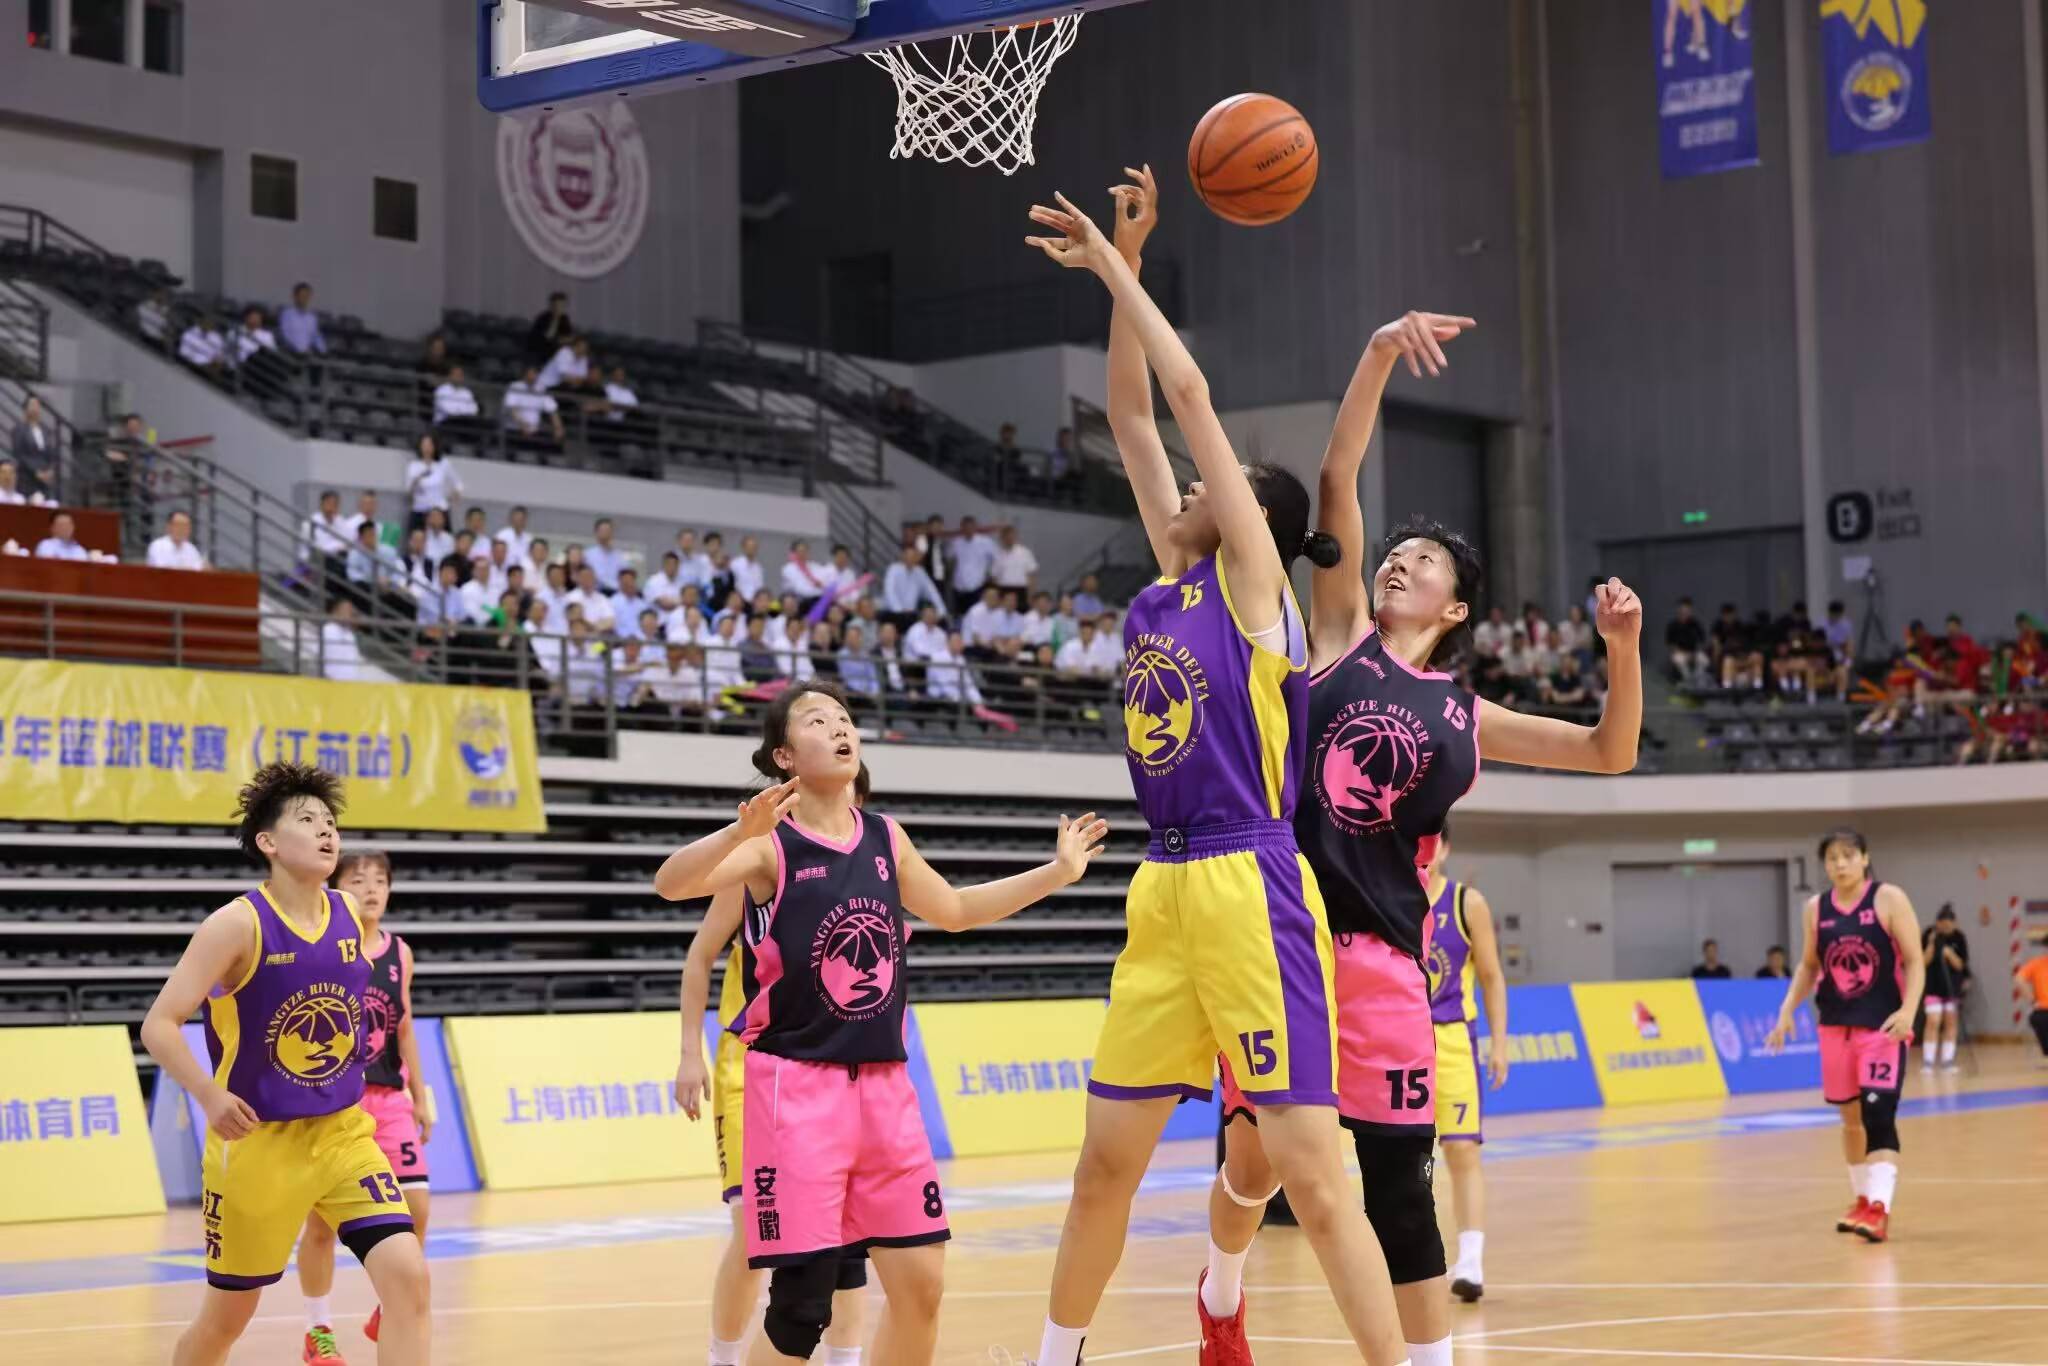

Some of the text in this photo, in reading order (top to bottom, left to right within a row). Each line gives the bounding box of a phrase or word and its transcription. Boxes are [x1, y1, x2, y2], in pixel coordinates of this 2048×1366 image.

[1180, 580, 1204, 612] 15
[1175, 646, 1210, 702] DELTA
[1316, 699, 1379, 750] YANGTZE
[1387, 703, 1430, 745] RIVER
[1442, 696, 1468, 731] 15
[0, 715, 411, 779] 年篮球联赛（江苏站）
[875, 856, 889, 881] 8
[810, 903, 846, 968] YANGTZE
[849, 897, 888, 916] RIVER
[1437, 913, 1448, 929] 7
[337, 938, 358, 963] 13
[389, 965, 399, 982] 5
[264, 982, 361, 1044] YANGTZE RIVER DELTA
[1238, 1029, 1277, 1077] 15
[1868, 1062, 1891, 1081] 12
[956, 1058, 1094, 1095] 上海市体育
[1386, 1068, 1430, 1110] 15
[502, 1080, 677, 1124] 上海市体育
[1453, 1103, 1469, 1125] 7
[402, 1142, 418, 1167] 5
[359, 1172, 403, 1204] 13
[754, 1165, 781, 1241] 安徽
[922, 1181, 943, 1218] 8
